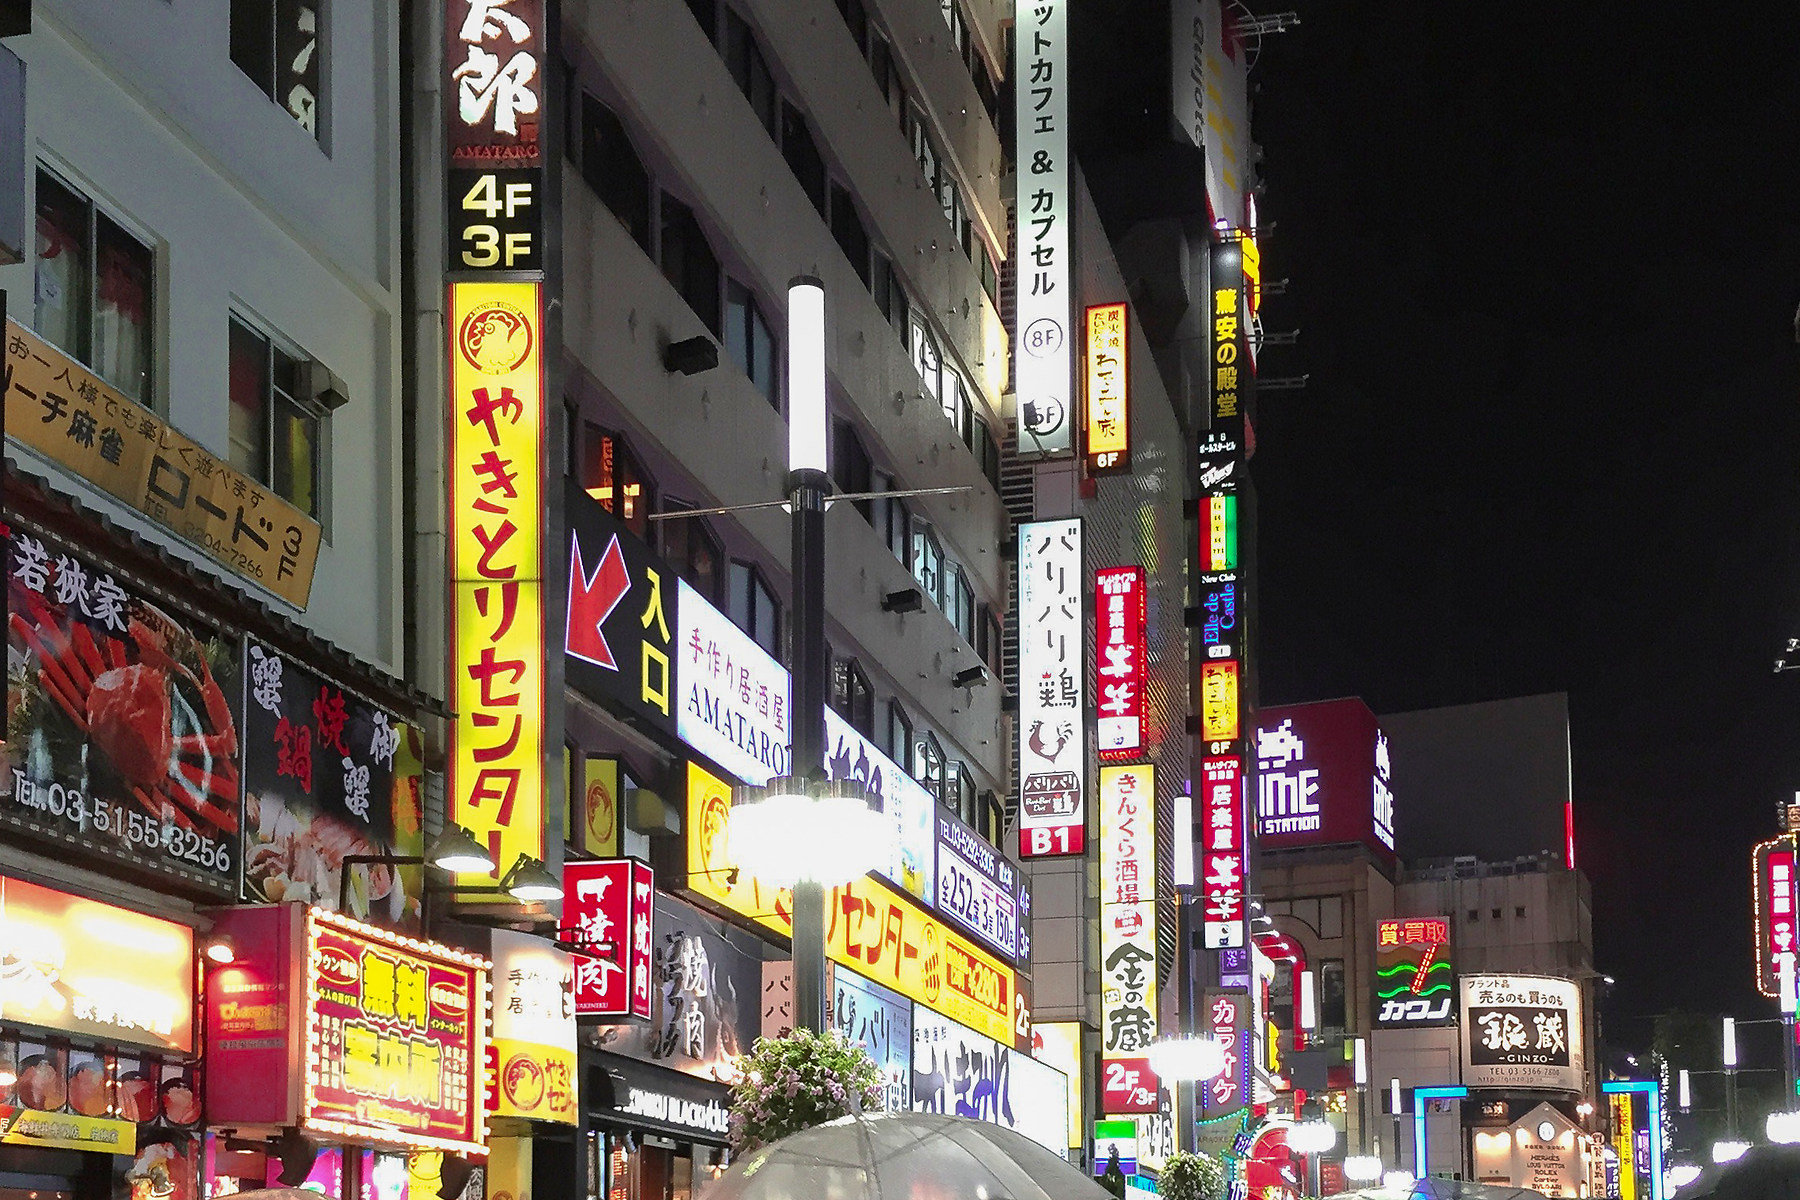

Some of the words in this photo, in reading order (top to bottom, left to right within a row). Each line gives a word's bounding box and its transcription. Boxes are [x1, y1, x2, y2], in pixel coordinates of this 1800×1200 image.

[1030, 0, 1055, 134] ットカフェ
[1031, 150, 1054, 175] &
[462, 174, 533, 218] 4F
[462, 225, 532, 267] 3F
[1031, 188, 1056, 296] カプセル
[1032, 329, 1055, 348] 8F
[149, 455, 274, 552] ロード
[276, 525, 303, 582] 3F
[1204, 592, 1219, 612] de
[1220, 582, 1236, 630] Castle
[641, 566, 670, 717] 入口
[1204, 616, 1219, 644] Elle
[688, 682, 786, 777] AMATARO
[1031, 826, 1069, 855] B1
[1265, 814, 1320, 834] STATION
[1015, 992, 1031, 1038] 2F
[1104, 942, 1156, 1053] 金の蔵
[1379, 998, 1452, 1022] カワノ
[1106, 1063, 1140, 1092] 2F
